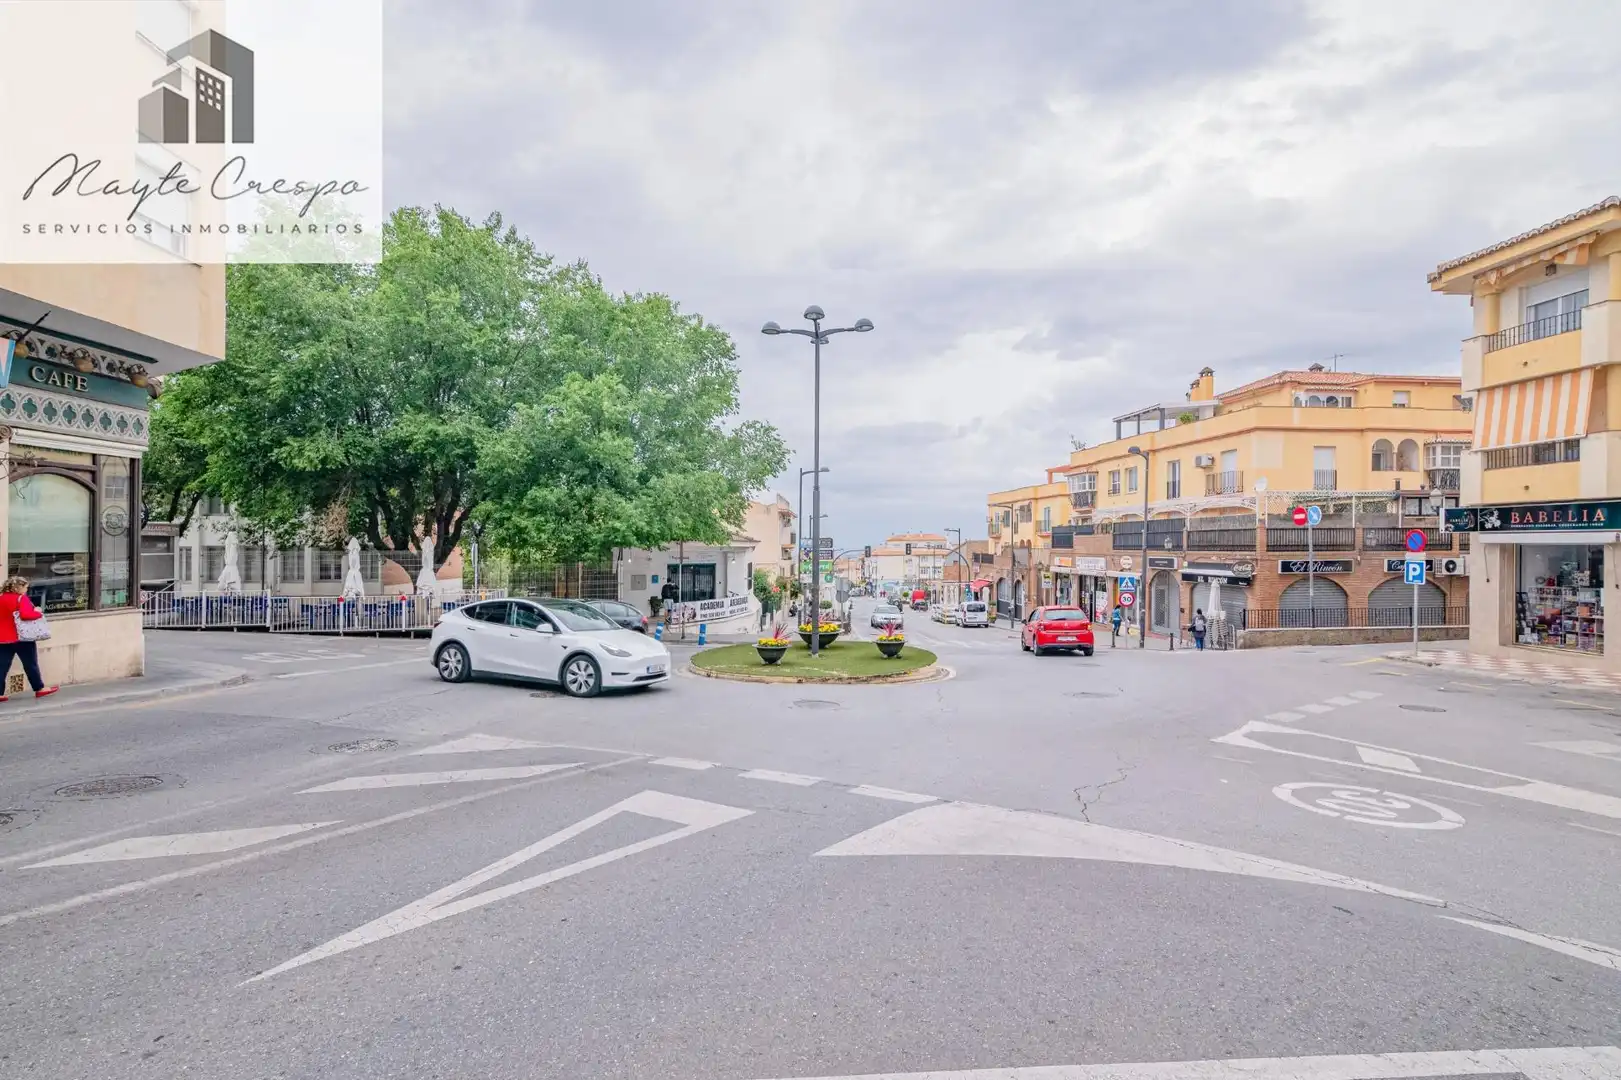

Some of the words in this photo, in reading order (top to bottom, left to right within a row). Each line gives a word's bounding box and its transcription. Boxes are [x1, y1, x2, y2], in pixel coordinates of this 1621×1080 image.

[31, 365, 89, 392] CAFE
[1510, 508, 1606, 524] BABELIA
[1289, 560, 1306, 573] El
[1408, 563, 1421, 582] P
[699, 600, 725, 612] ACADEMIA
[1122, 595, 1133, 603] 30
